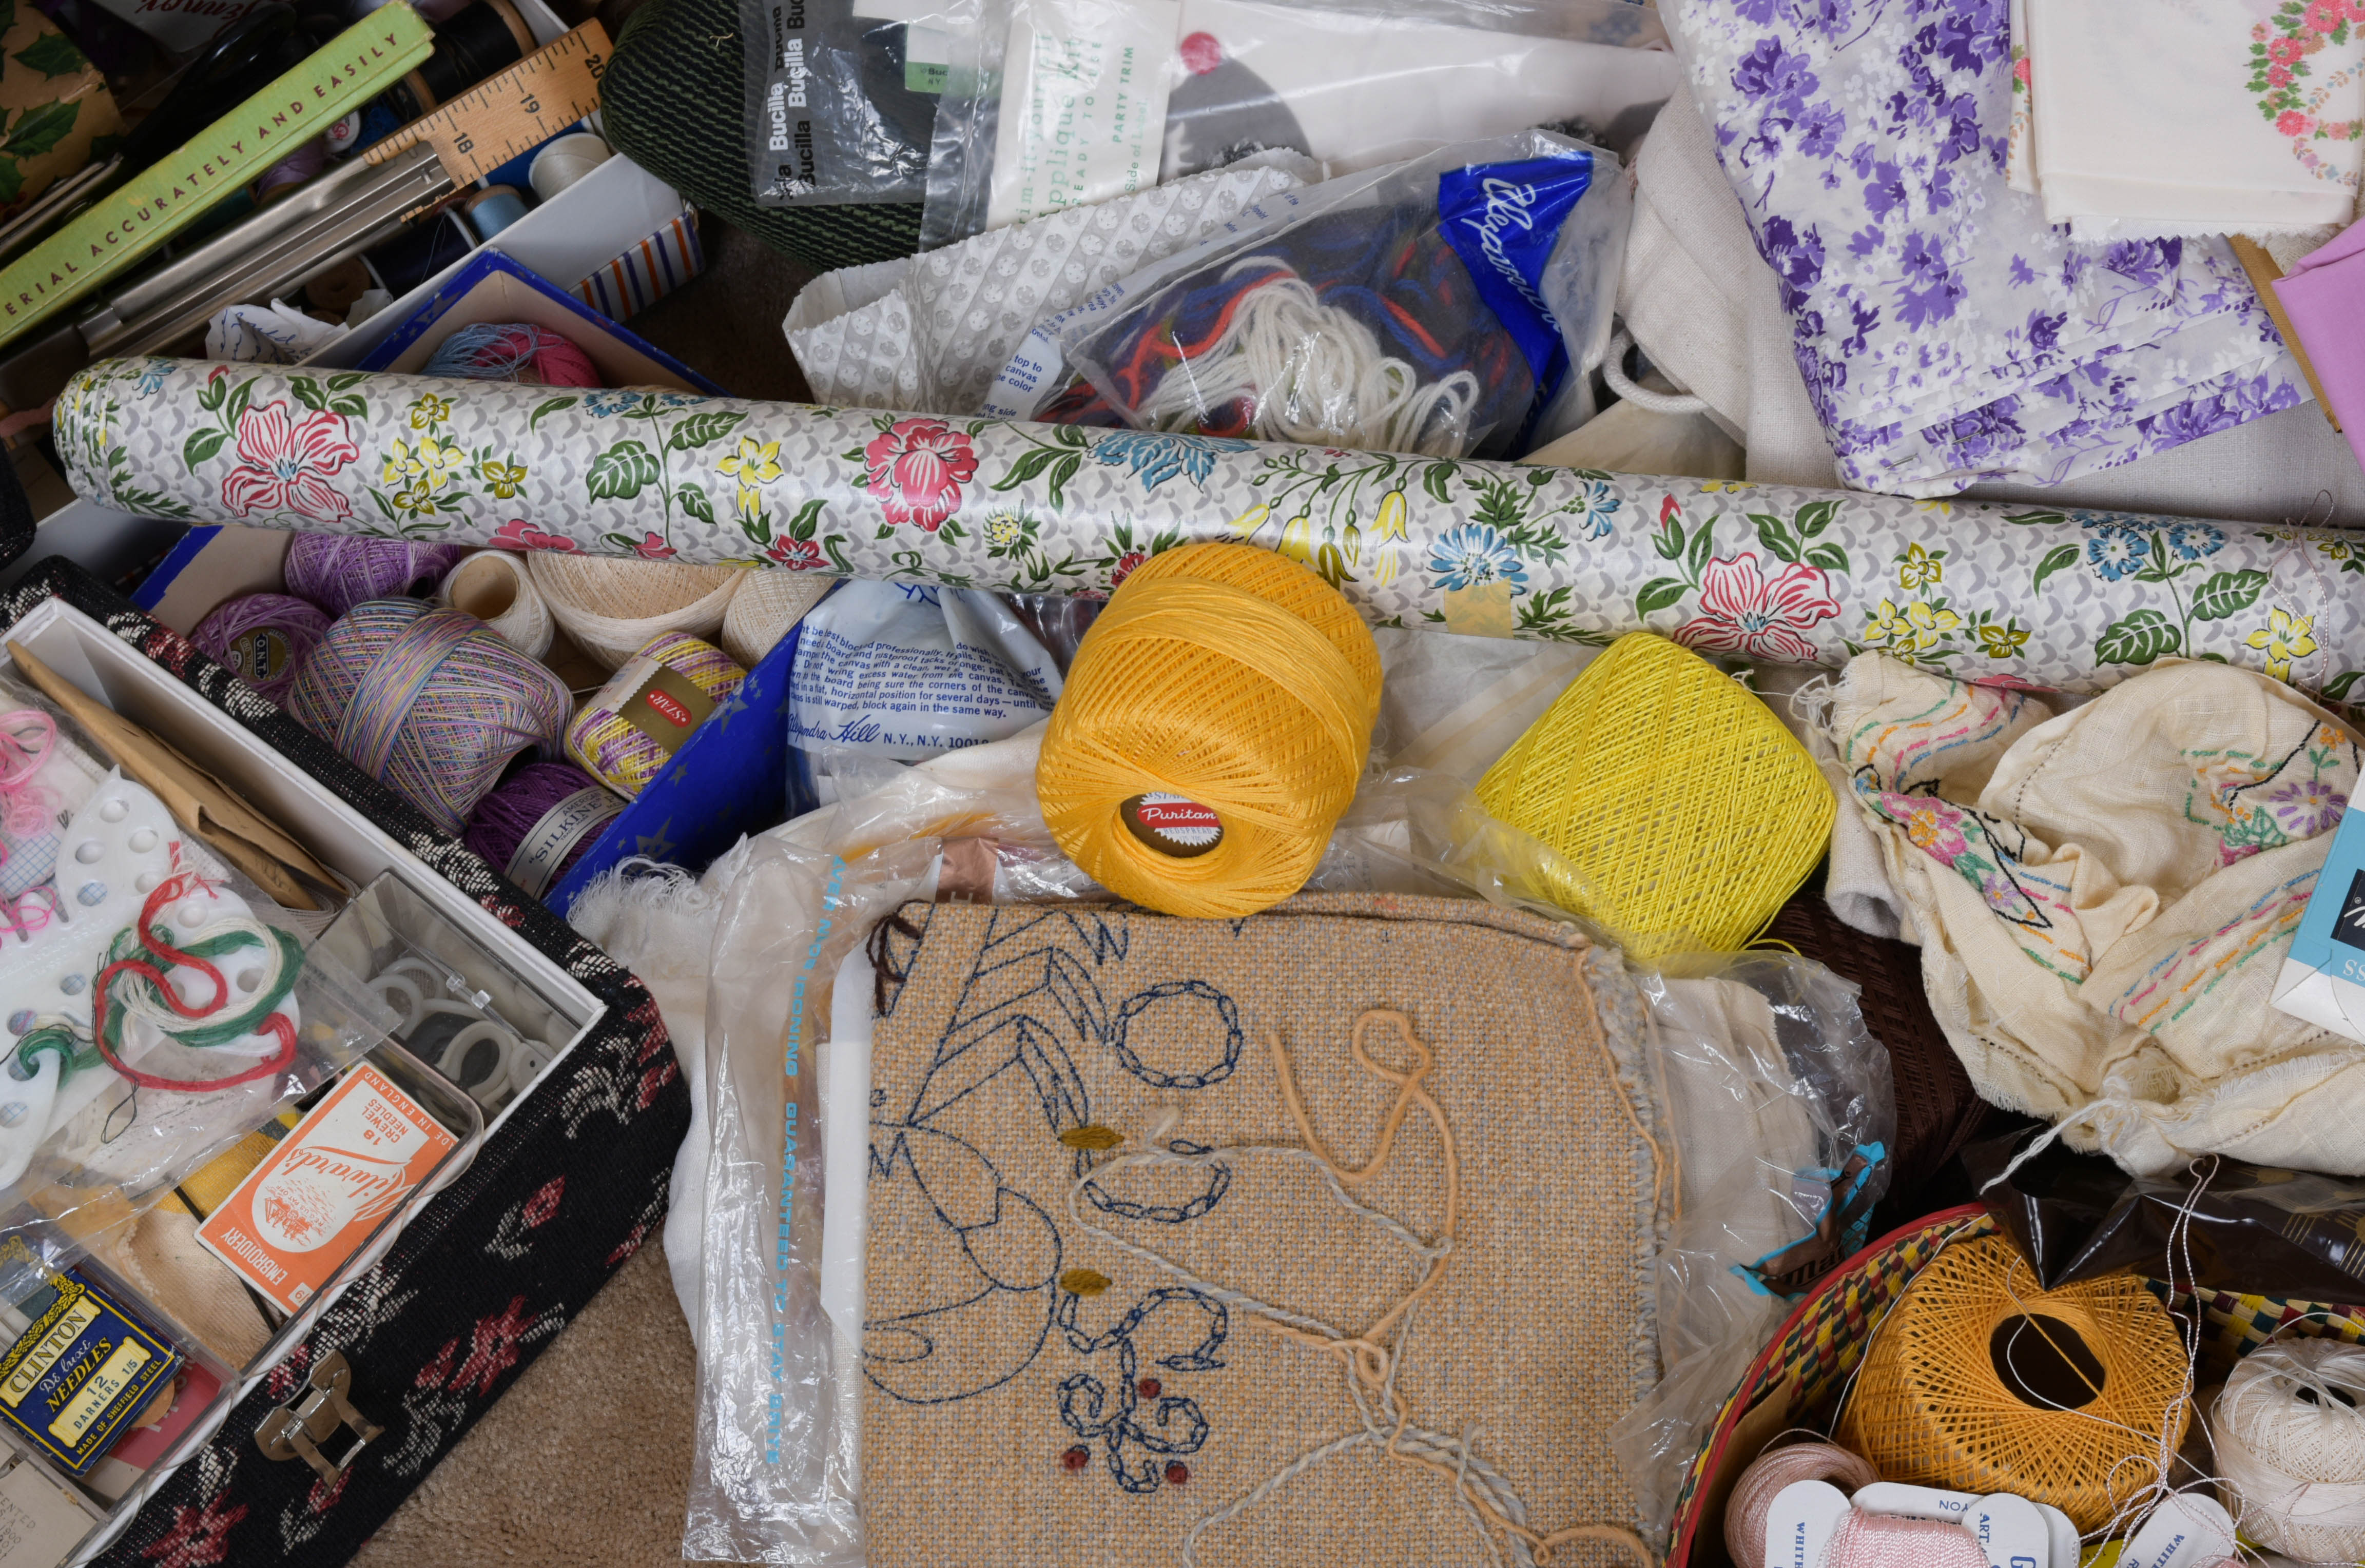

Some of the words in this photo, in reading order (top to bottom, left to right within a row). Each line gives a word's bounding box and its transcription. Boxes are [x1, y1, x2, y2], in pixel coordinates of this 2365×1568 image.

[585, 53, 605, 79] 20
[784, 38, 807, 107] Bucilla
[520, 93, 540, 113] 19
[1082, 96, 1095, 119] TO
[1112, 93, 1128, 143] PARTY
[1120, 47, 1133, 84] TRIM
[768, 82, 788, 150] Bucilla
[453, 132, 474, 154] 18
[4, 262, 78, 316] ERIAL
[91, 141, 244, 257] ACCURATELY
[259, 101, 303, 139] AND
[313, 32, 397, 97] EASILY
[1125, 162, 1139, 191] Side
[1005, 365, 1038, 383] canvas
[1014, 355, 1030, 367] top
[1032, 362, 1042, 372] to
[1009, 378, 1034, 393] color
[998, 408, 1017, 417] side
[812, 626, 823, 636] be
[876, 642, 943, 656] professionally.
[971, 645, 990, 656] wish
[826, 641, 852, 659] board
[854, 651, 872, 659] and
[875, 651, 918, 662] rustproof
[980, 655, 992, 663] Do
[257, 639, 266, 673] O.N.T.
[821, 651, 835, 664] the
[838, 660, 870, 669] canvas
[903, 663, 929, 672] clean,
[811, 673, 820, 681] the
[824, 676, 854, 688] board
[858, 681, 881, 689] being
[909, 680, 924, 689] the
[928, 681, 966, 690] corners
[987, 685, 1002, 694] the
[828, 667, 854, 679] wring
[859, 671, 886, 679] excess
[891, 671, 917, 679] water
[969, 673, 1005, 684] canvas.
[653, 695, 685, 719] STAR
[801, 682, 807, 691] in
[815, 684, 827, 695] flat,
[831, 687, 877, 699] horizontal
[879, 691, 916, 700] position
[920, 691, 933, 700] for
[936, 694, 973, 703] several
[976, 694, 1000, 706] days
[1014, 700, 1036, 709] until
[805, 694, 811, 703] is
[812, 694, 822, 705] still
[825, 697, 859, 711] warped,
[862, 700, 887, 710] block
[890, 702, 916, 712] again
[920, 702, 929, 711] in
[933, 703, 949, 712] the
[952, 707, 980, 715] same
[984, 709, 1006, 719] way.
[828, 714, 880, 742] Hill
[917, 734, 943, 748] N.Y.
[1141, 808, 1216, 821] Puritan
[785, 976, 807, 1076] IRONING
[364, 1072, 416, 1116] ENGLAND
[362, 1106, 400, 1143] CREWEL
[368, 1099, 409, 1136] NEEDLES
[417, 1116, 432, 1130] IN
[363, 1129, 381, 1146] 18
[281, 1148, 417, 1222] Milward's
[776, 1102, 798, 1271] GUARANTEED
[287, 1196, 299, 1205] PAT
[220, 1227, 288, 1285] EMBROIDERY
[773, 1278, 788, 1311] TO
[9, 1309, 87, 1394] CLINTON
[770, 1322, 785, 1383] STAY
[45, 1337, 112, 1412] NEEDLES
[86, 1375, 108, 1396] 12
[74, 1380, 120, 1429] DARNERS
[122, 1359, 138, 1375] 1/5
[76, 1433, 97, 1456] MADE
[96, 1421, 108, 1432] OF
[107, 1384, 139, 1420] SHEFFIELD
[140, 1360, 162, 1381] STEEL
[766, 1394, 783, 1464] BRITE
